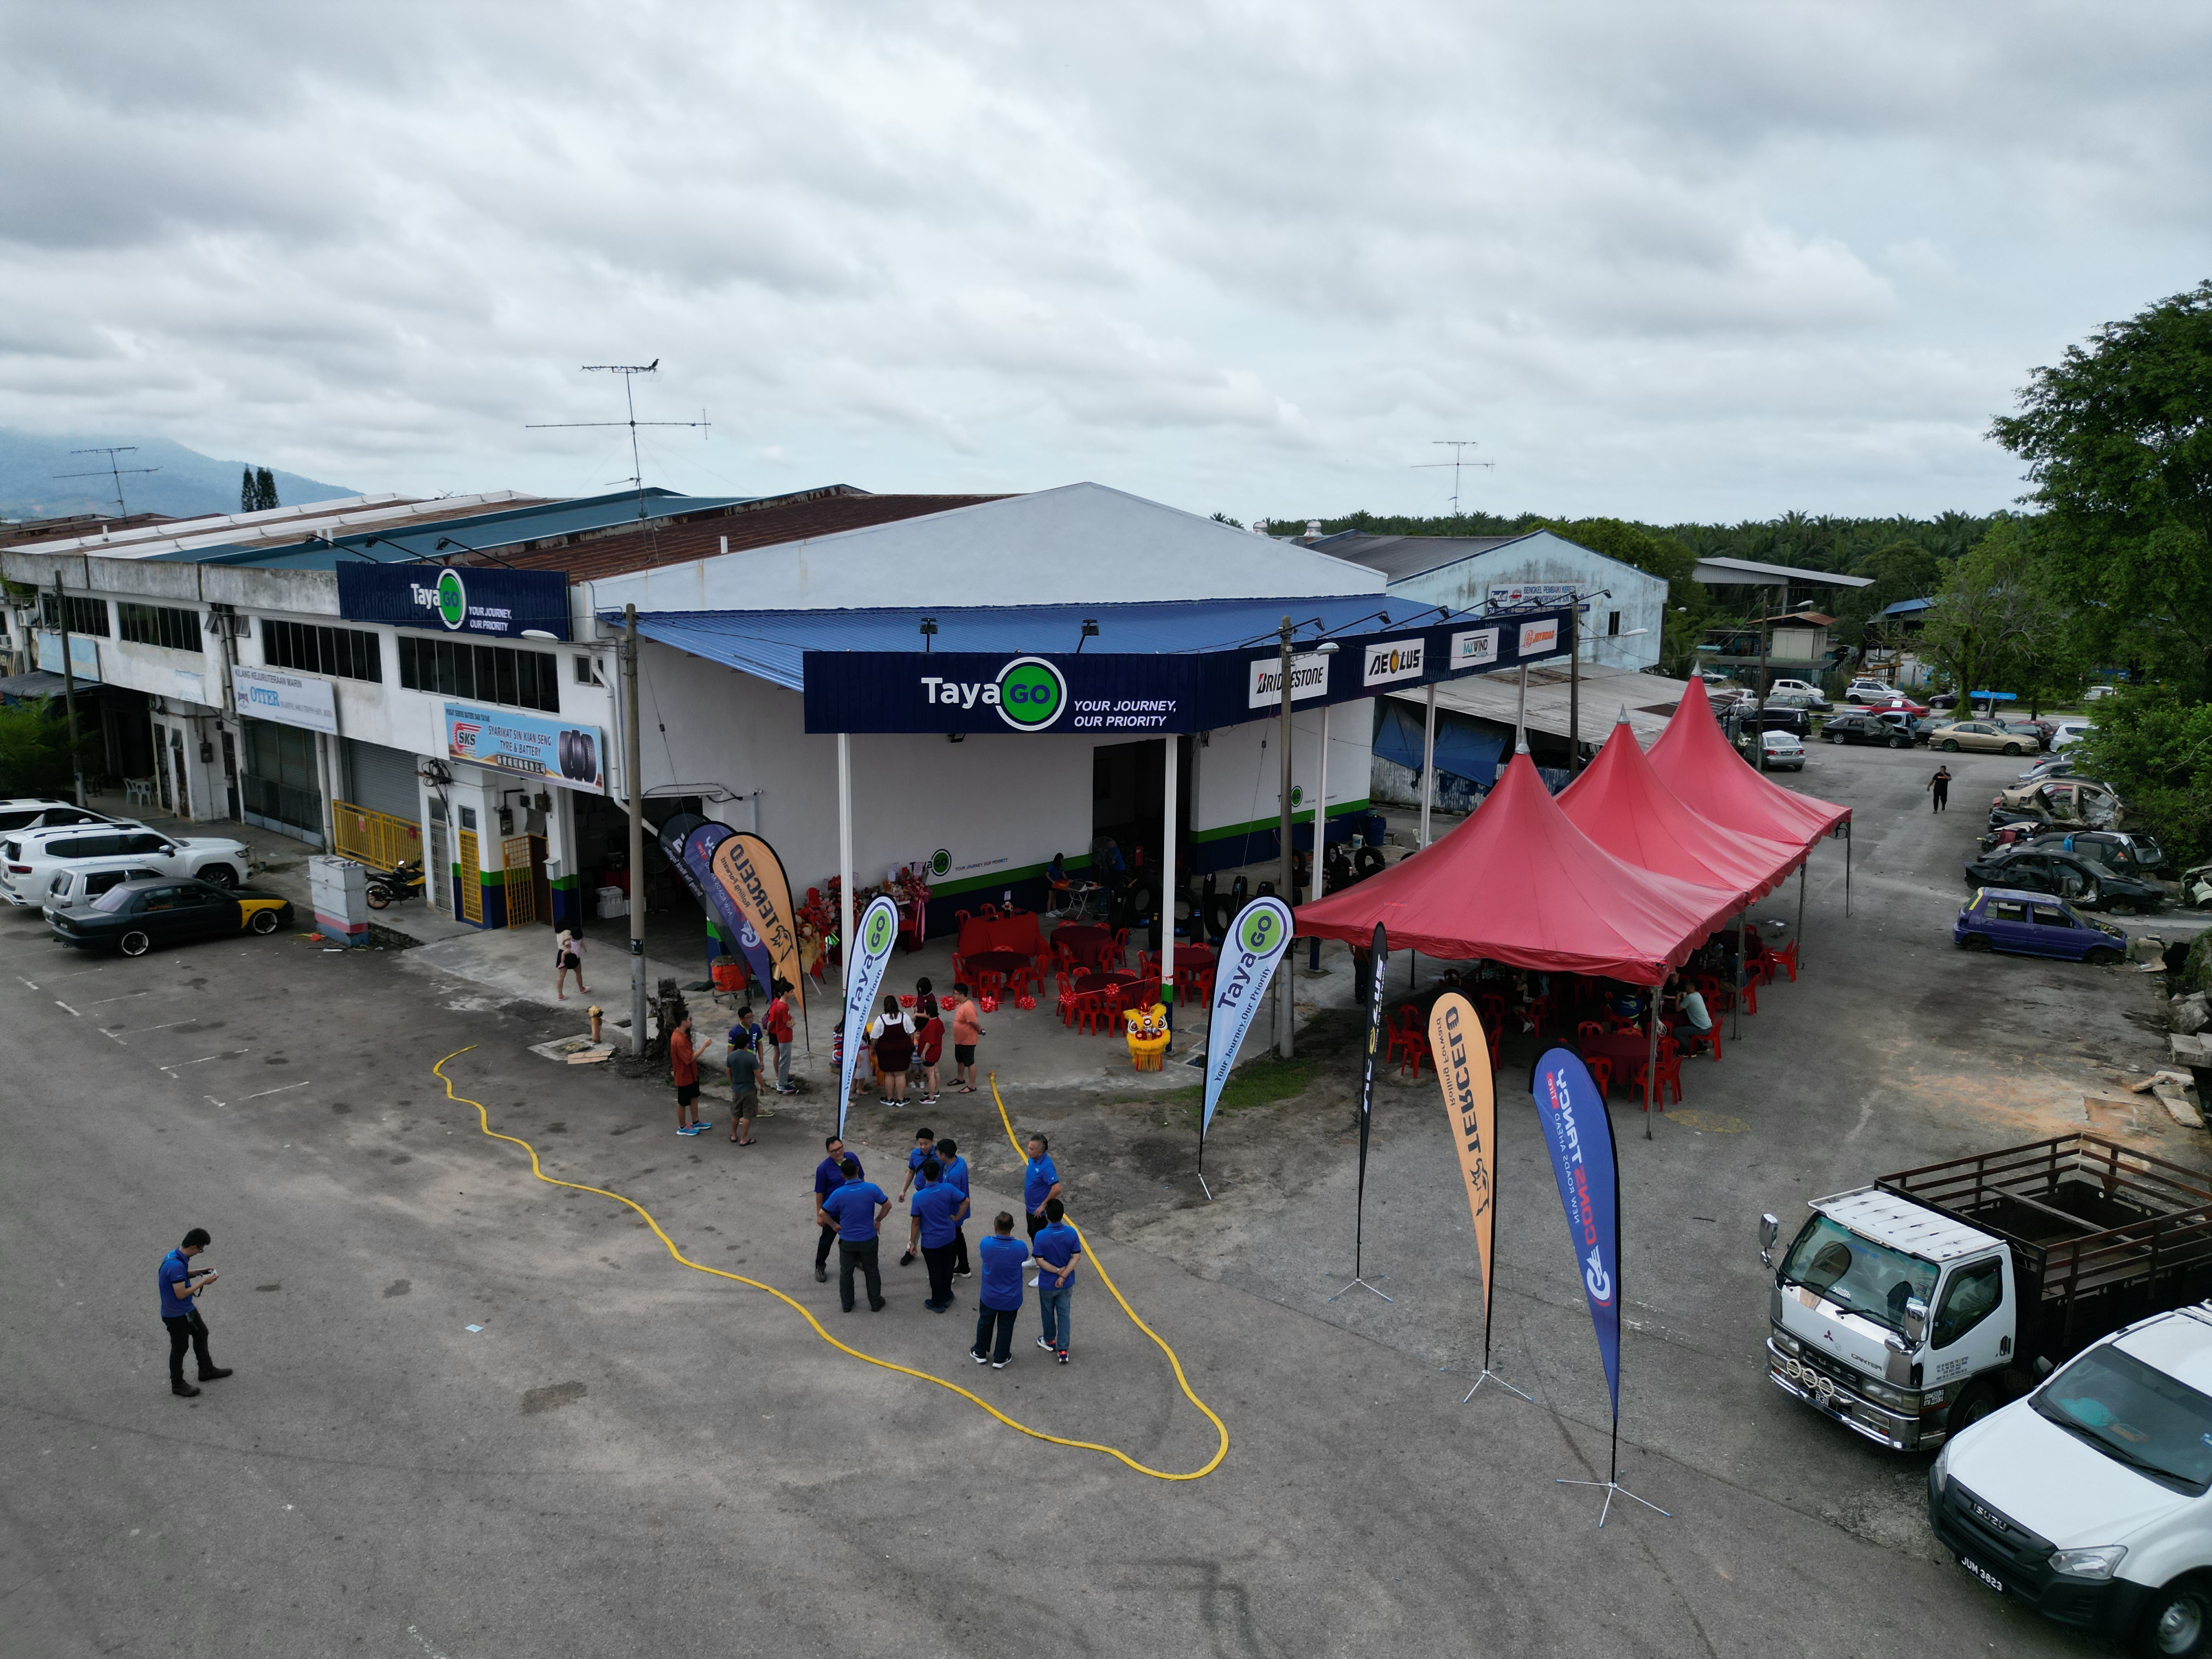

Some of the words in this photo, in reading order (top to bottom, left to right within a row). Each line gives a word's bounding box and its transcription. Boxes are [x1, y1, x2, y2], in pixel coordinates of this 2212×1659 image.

[469, 606, 484, 616] YOUR
[485, 607, 512, 619] JOURNEY,
[470, 619, 482, 629] OUR
[483, 620, 509, 631] PRIORITY
[1368, 649, 1421, 676] AEOLUS
[1256, 666, 1324, 695] BRIDESTONE
[250, 686, 280, 707] OTTER
[1074, 700, 1111, 712] YOUR
[1113, 700, 1176, 713] JOURNEY,
[1074, 715, 1103, 727] OUR
[1106, 715, 1166, 727] PRIORITY
[459, 731, 476, 746] SKS
[488, 725, 512, 739] SYARIKAT
[514, 729, 522, 741] SIN
[523, 731, 536, 743] KIAN
[538, 734, 551, 746] SENG
[500, 740, 512, 752] TYRE
[514, 744, 517, 753] &
[519, 744, 541, 758] BATTERY
[866, 966, 883, 1002] Priority
[1214, 1063, 1228, 1082] Your
[1250, 966, 1271, 1001] Priority
[1851, 1353, 1882, 1372] CANTER
[1973, 1503, 2007, 1531] ISUZU
[1961, 1556, 1978, 1575] JUM
[1980, 1569, 2002, 1592] 3623
